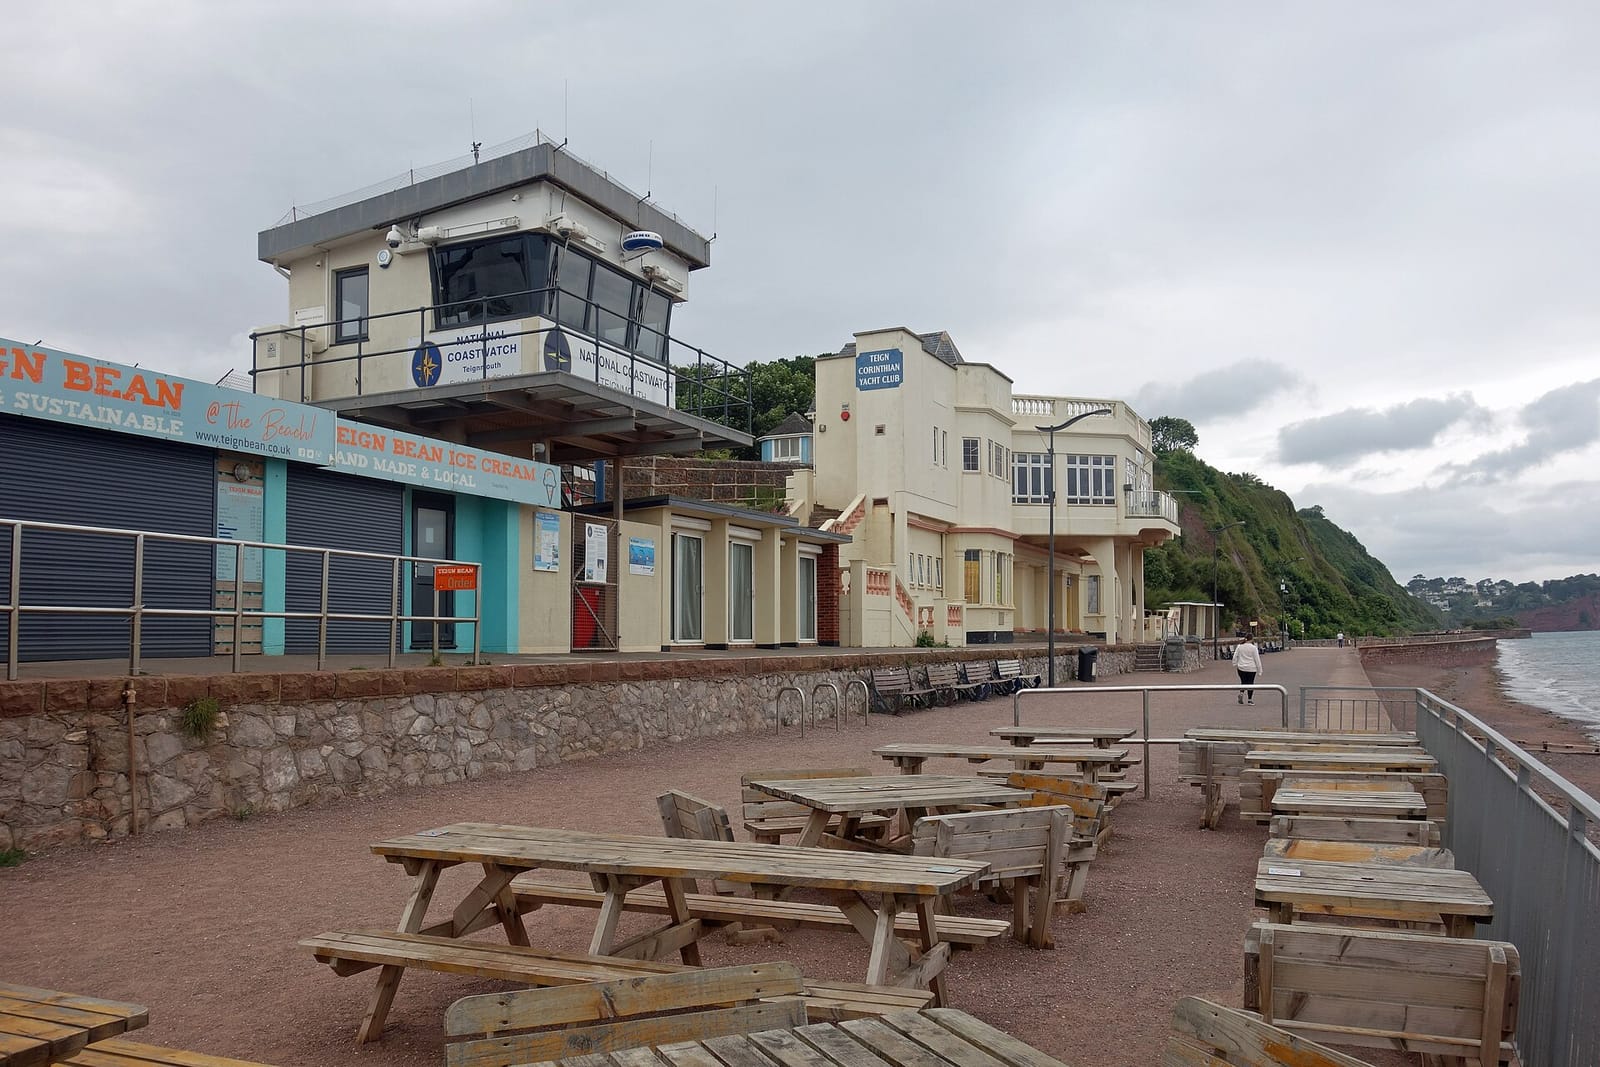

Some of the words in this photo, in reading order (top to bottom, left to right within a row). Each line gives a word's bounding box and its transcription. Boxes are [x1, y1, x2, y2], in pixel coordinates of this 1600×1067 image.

[447, 343, 517, 362] COASTWATCH
[579, 347, 621, 374] NATONAL
[870, 353, 890, 362] TEIGN
[463, 361, 502, 374] Teignouth
[858, 363, 900, 374] CORINTHIAN
[859, 376, 880, 385] YACHT
[882, 374, 900, 383] CLUB
[63, 359, 184, 410] BEAN
[14, 391, 183, 436] SUSTAINABLE
[195, 431, 291, 455] www.teignbean.co.uk
[337, 426, 386, 452] EIGN
[392, 437, 443, 463] BEAN
[448, 450, 477, 470] ICE
[481, 457, 536, 481] CREAM
[374, 457, 416, 477] MADE
[421, 466, 429, 479] &
[433, 468, 476, 487] LOCAL
